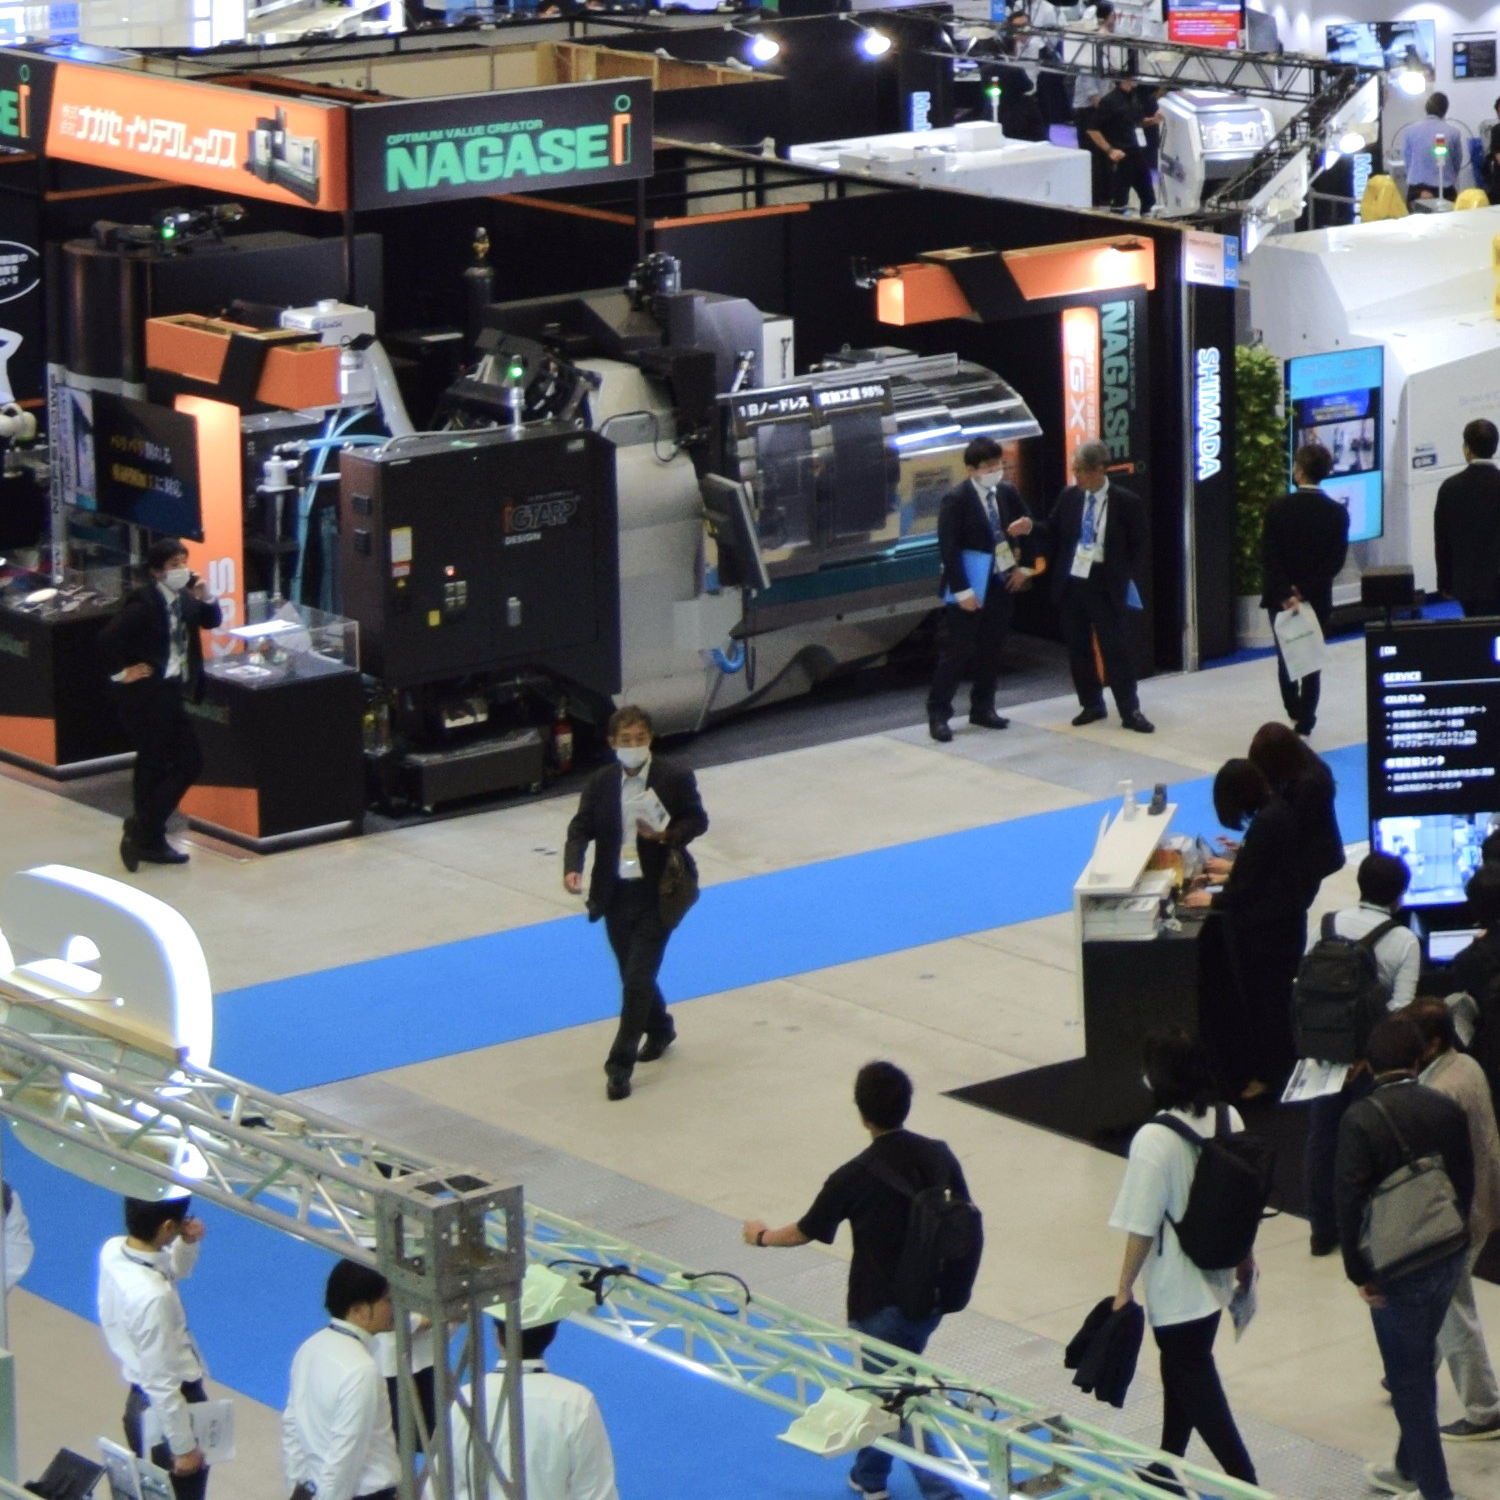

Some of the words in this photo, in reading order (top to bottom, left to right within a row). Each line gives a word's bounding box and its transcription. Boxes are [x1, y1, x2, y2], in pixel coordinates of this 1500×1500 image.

[445, 125, 485, 138] VALUE
[486, 118, 544, 134] CREATOR
[1197, 348, 1221, 481] SHIMADA
